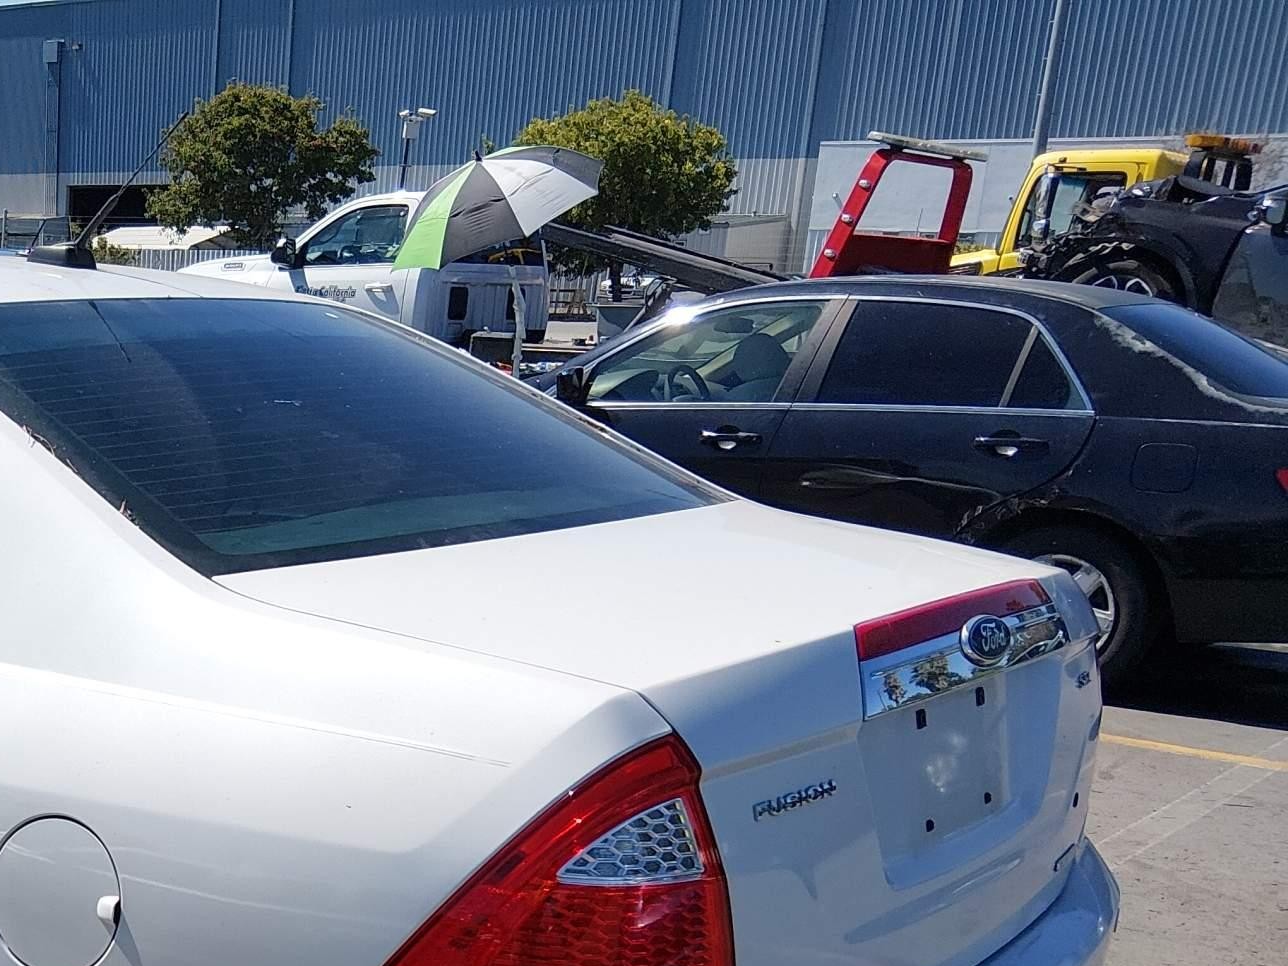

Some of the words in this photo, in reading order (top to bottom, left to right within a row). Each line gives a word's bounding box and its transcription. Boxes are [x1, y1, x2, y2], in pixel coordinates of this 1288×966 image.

[318, 285, 357, 297] California
[979, 622, 1008, 652] Ford
[752, 778, 837, 823] FUSION
